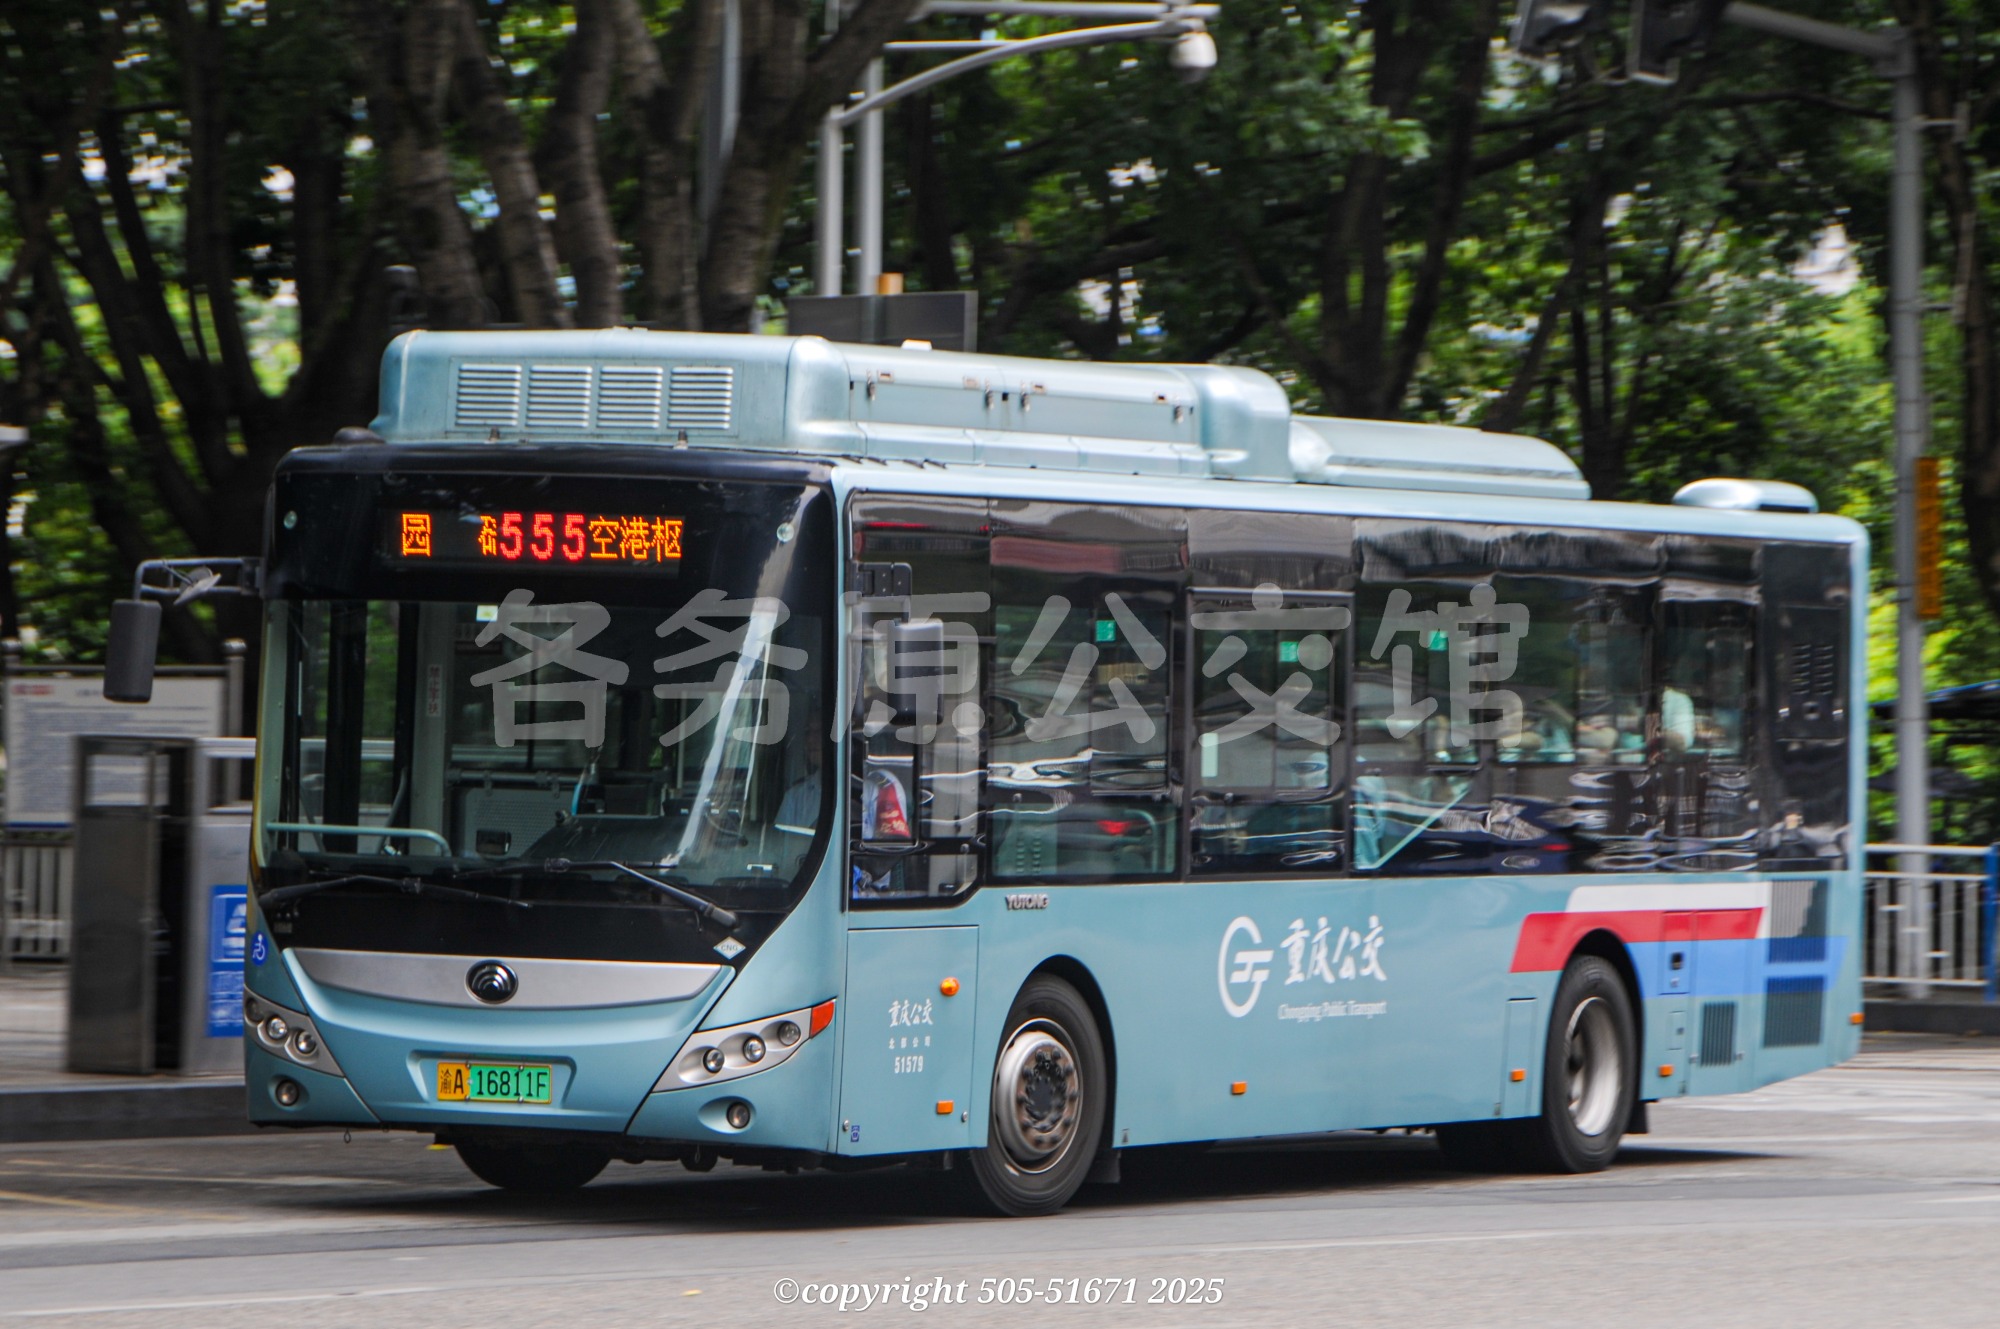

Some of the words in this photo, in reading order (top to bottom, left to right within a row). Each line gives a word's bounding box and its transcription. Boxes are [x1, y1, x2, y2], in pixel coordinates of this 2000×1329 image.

[500, 513, 586, 560] 555
[1005, 894, 1049, 910] YUTONG
[1279, 915, 1388, 986] 重庆公交
[894, 1055, 924, 1074] 51579
